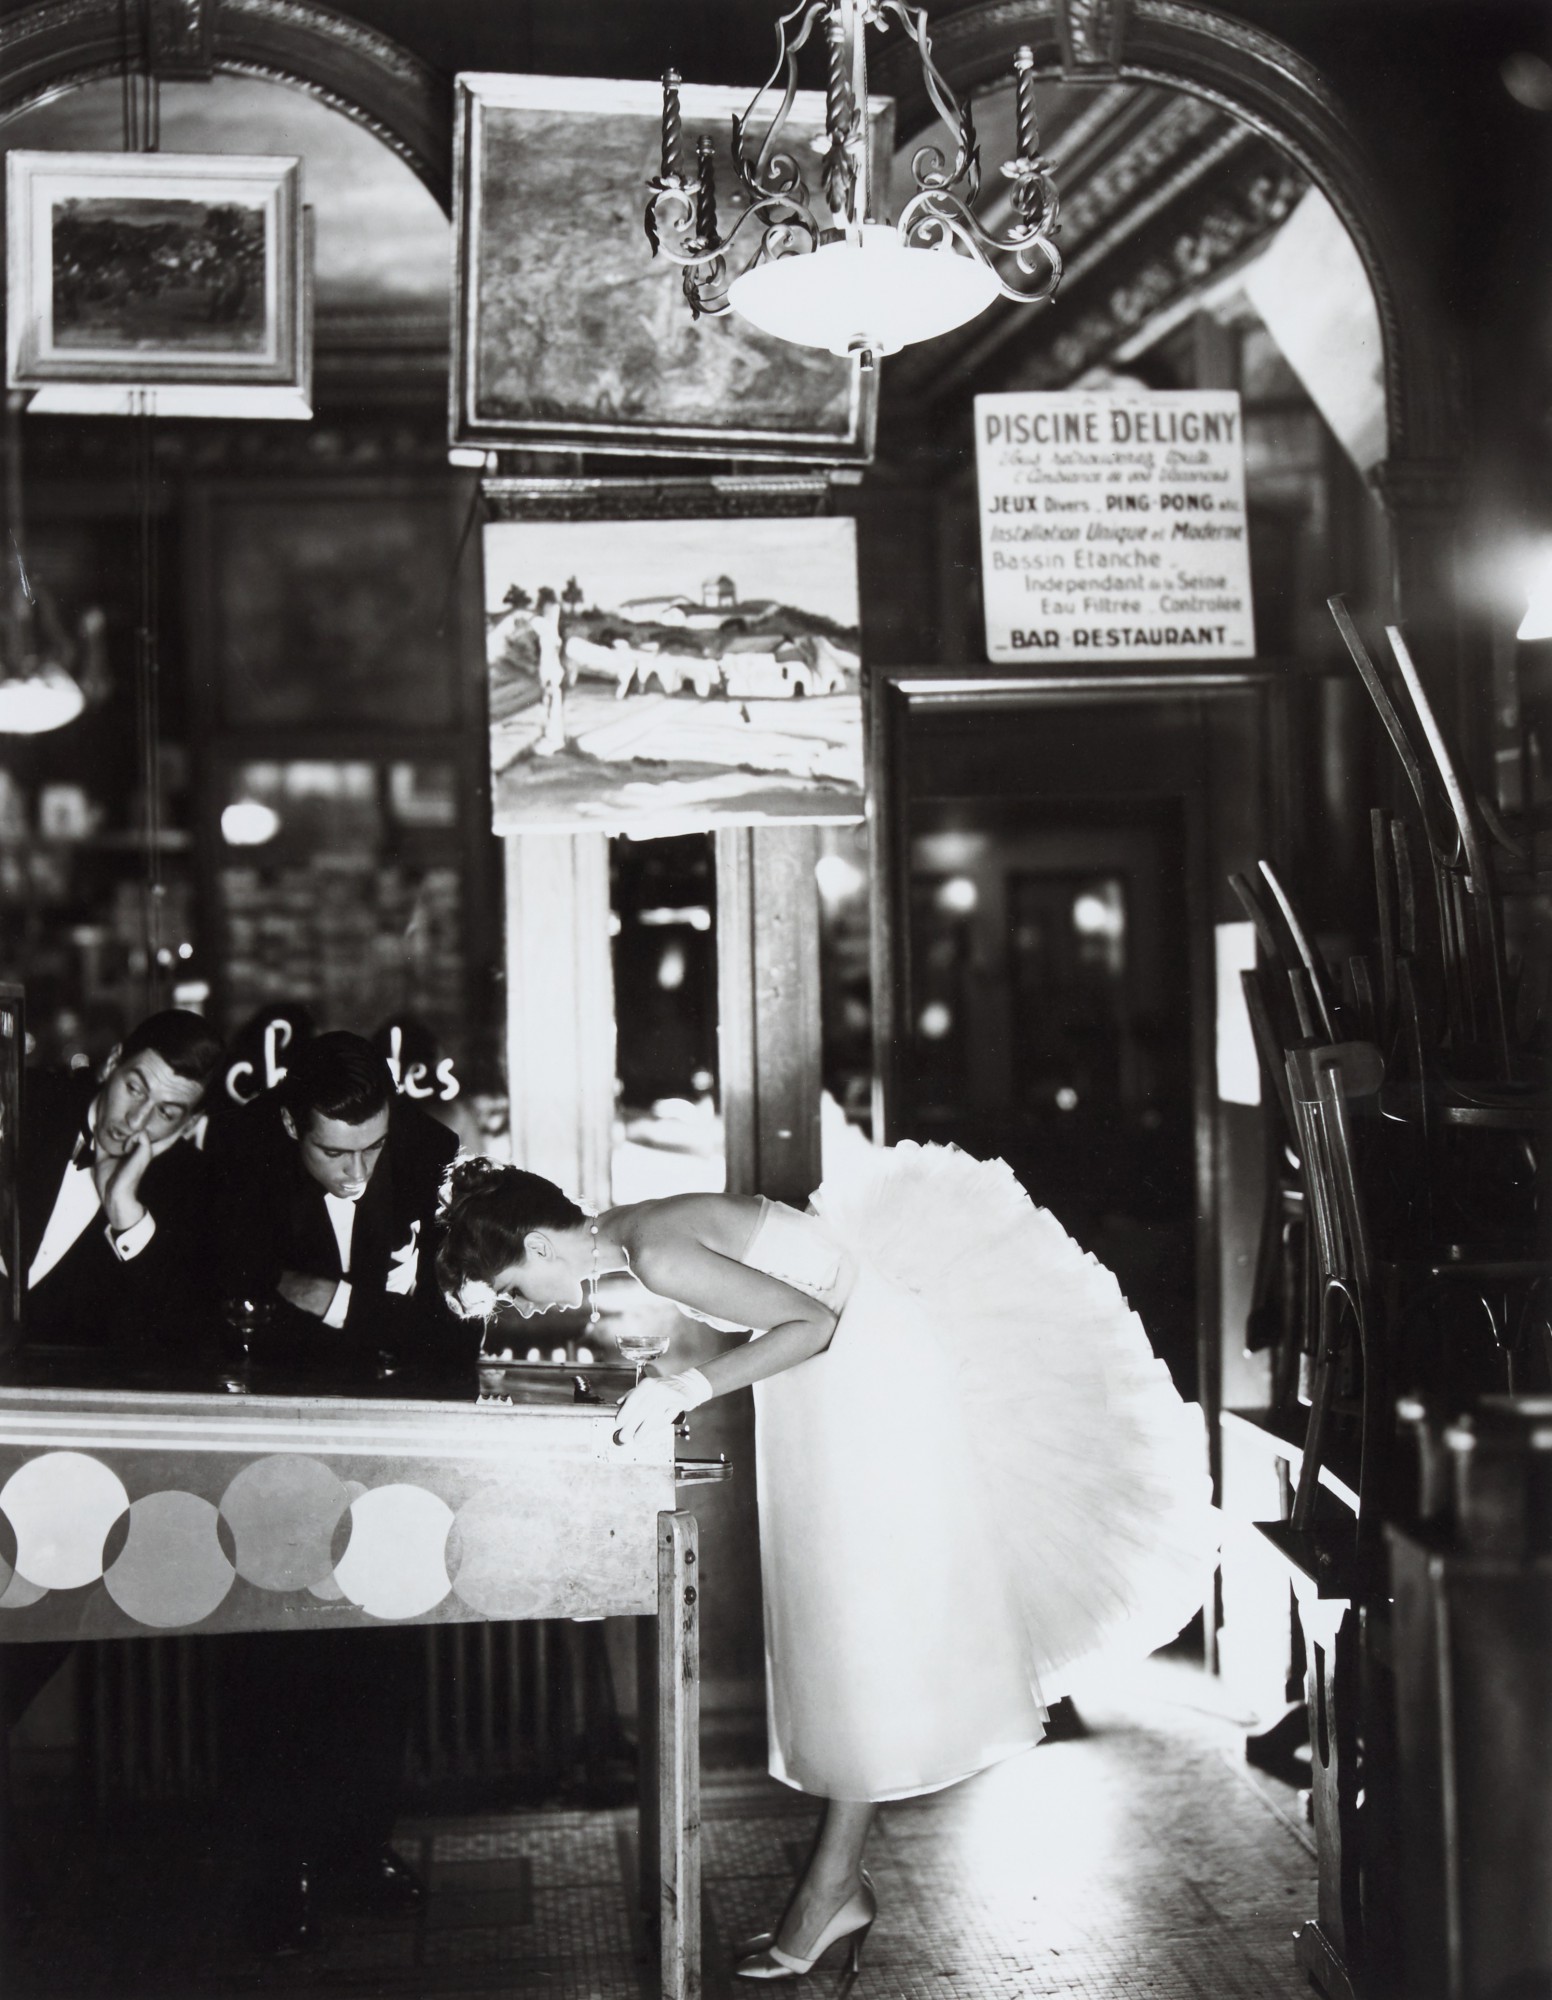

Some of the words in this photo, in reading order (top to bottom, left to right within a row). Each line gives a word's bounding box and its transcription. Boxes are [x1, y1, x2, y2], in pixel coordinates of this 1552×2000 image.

[985, 413, 1098, 444] PISCINE
[1109, 409, 1237, 444] DELIGNY
[988, 496, 1038, 513] JEUX
[1045, 496, 1090, 513] Divers
[989, 522, 1081, 542] Installation
[1086, 521, 1148, 544] Unique
[1171, 520, 1243, 541] Moderne
[992, 551, 1065, 570] Bassin
[1177, 571, 1227, 591] Seine
[1040, 597, 1075, 616] Eau
